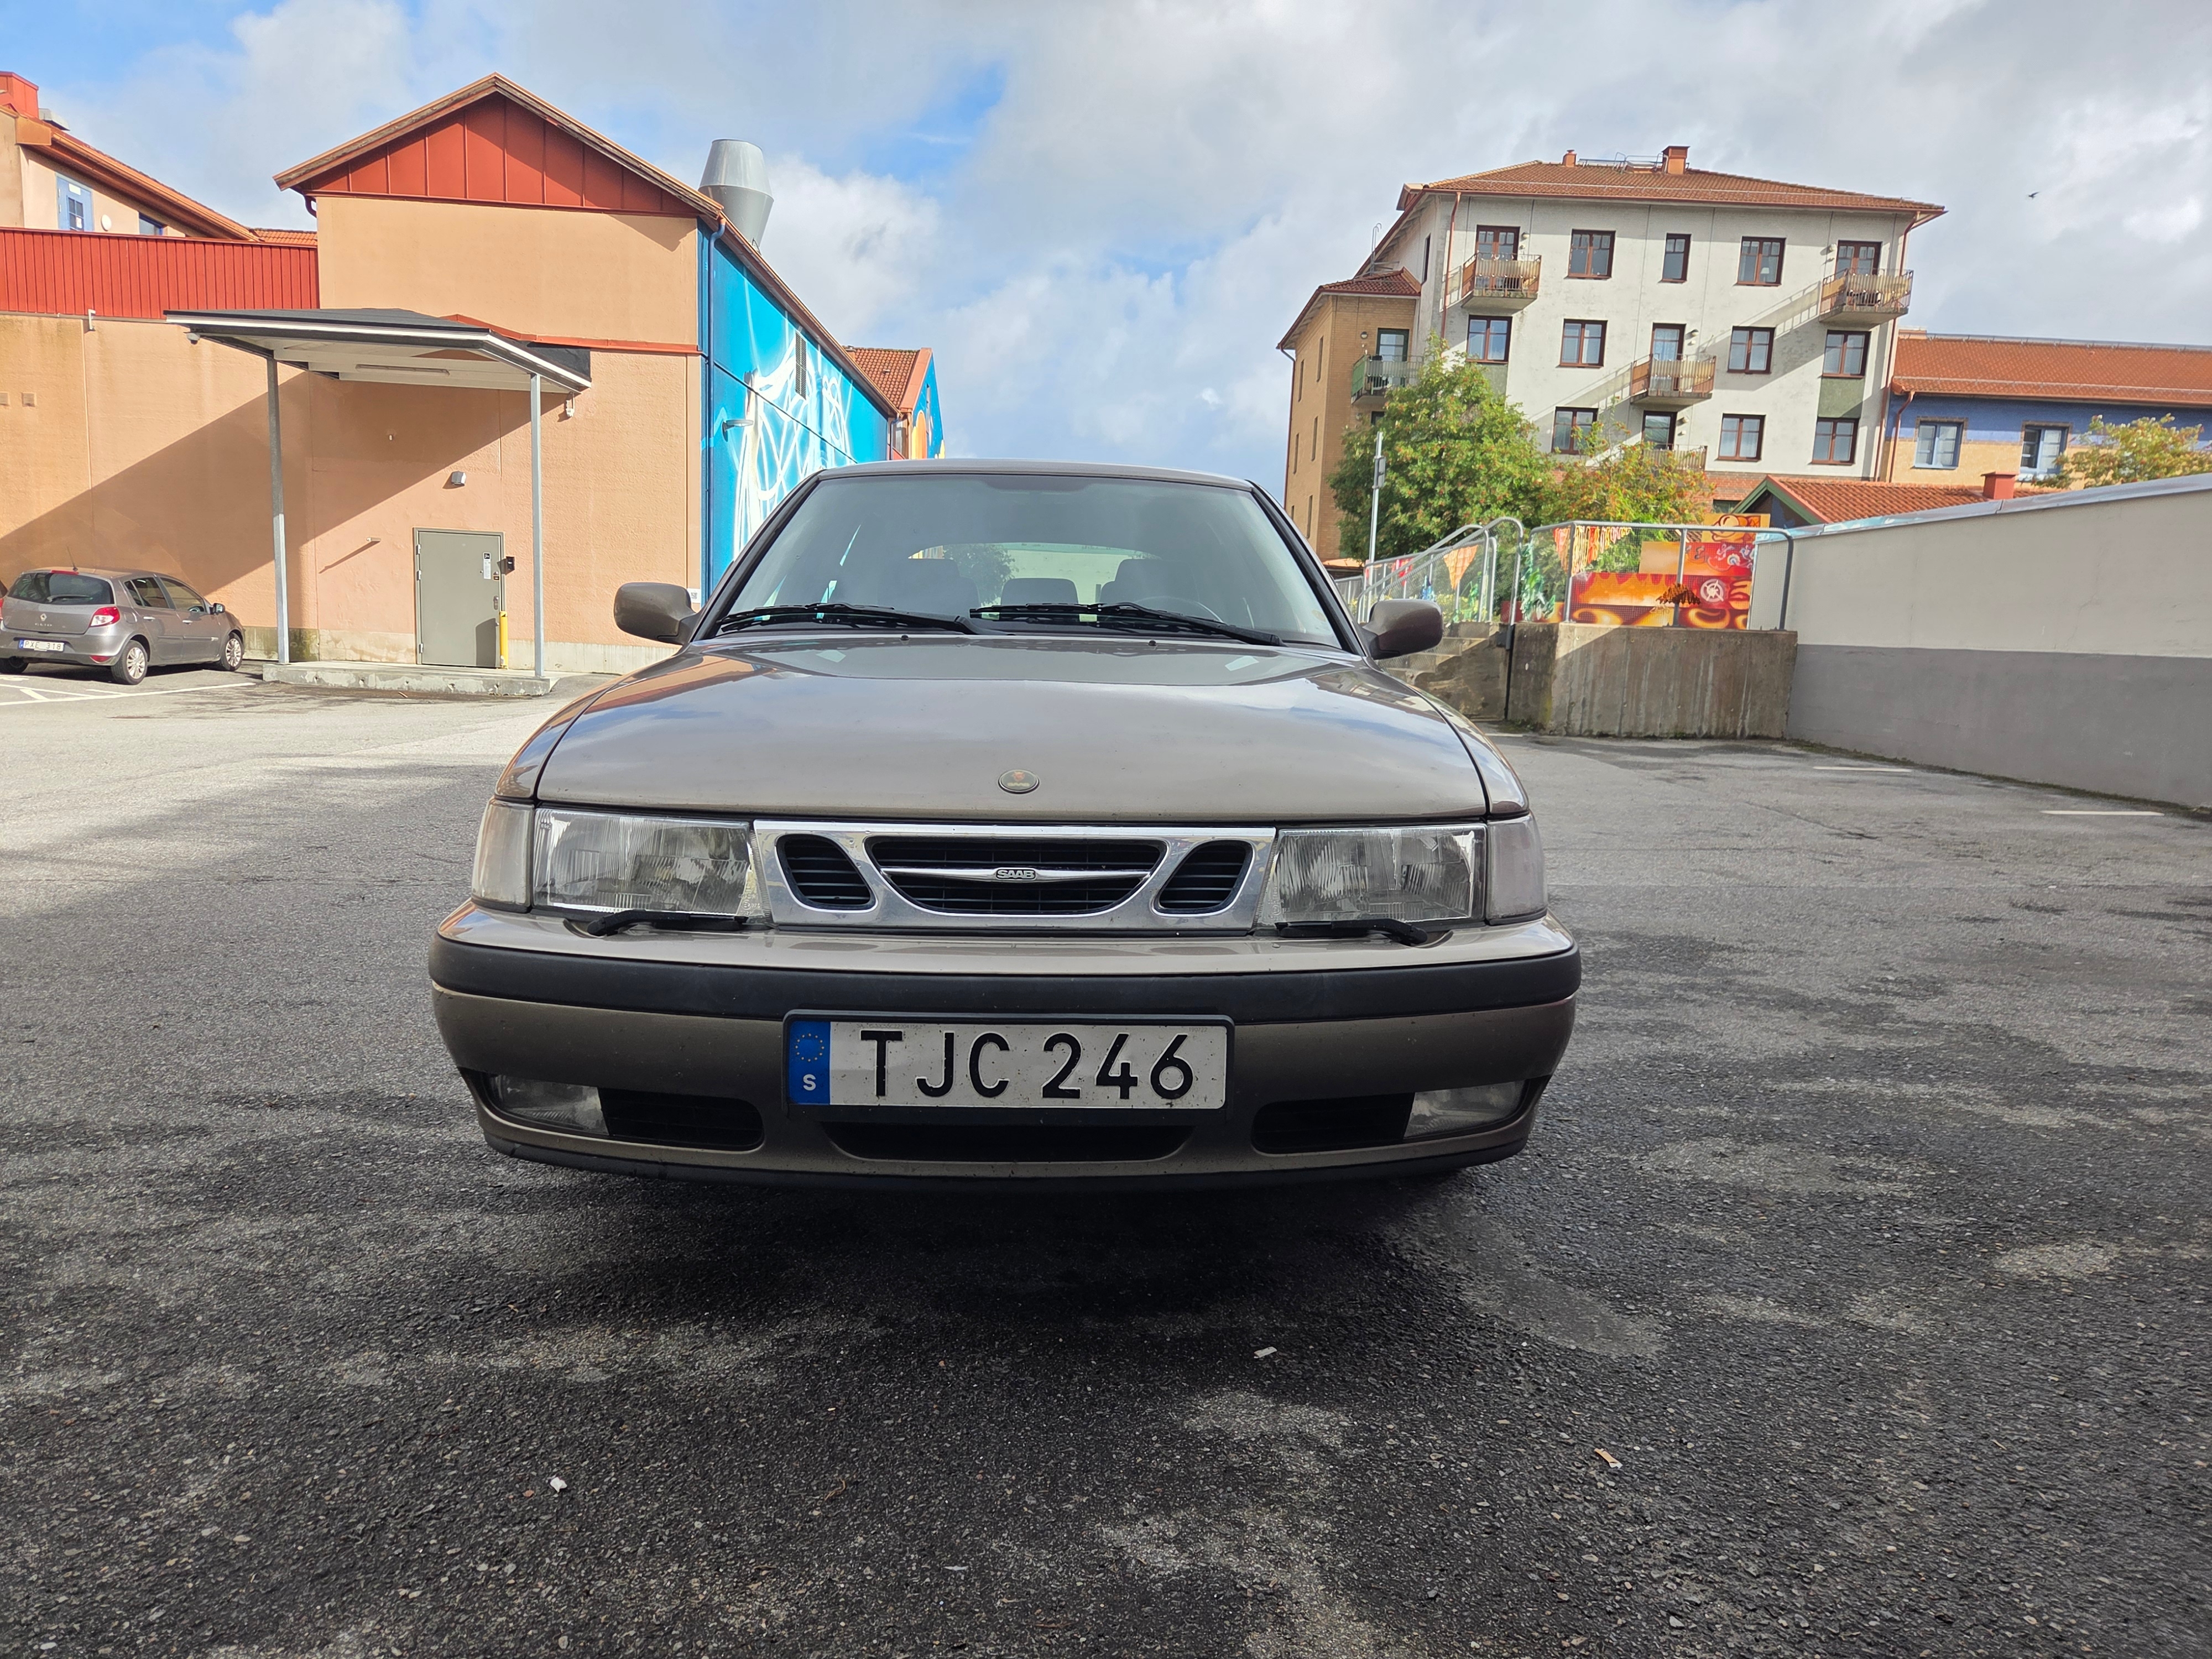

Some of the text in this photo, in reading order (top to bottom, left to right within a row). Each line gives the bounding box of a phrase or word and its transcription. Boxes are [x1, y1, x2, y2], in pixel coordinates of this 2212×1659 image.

[24, 640, 40, 649] PXE
[997, 869, 1035, 879] SAAB
[860, 1030, 1194, 1100] TJC 246
[802, 1073, 816, 1091] S
